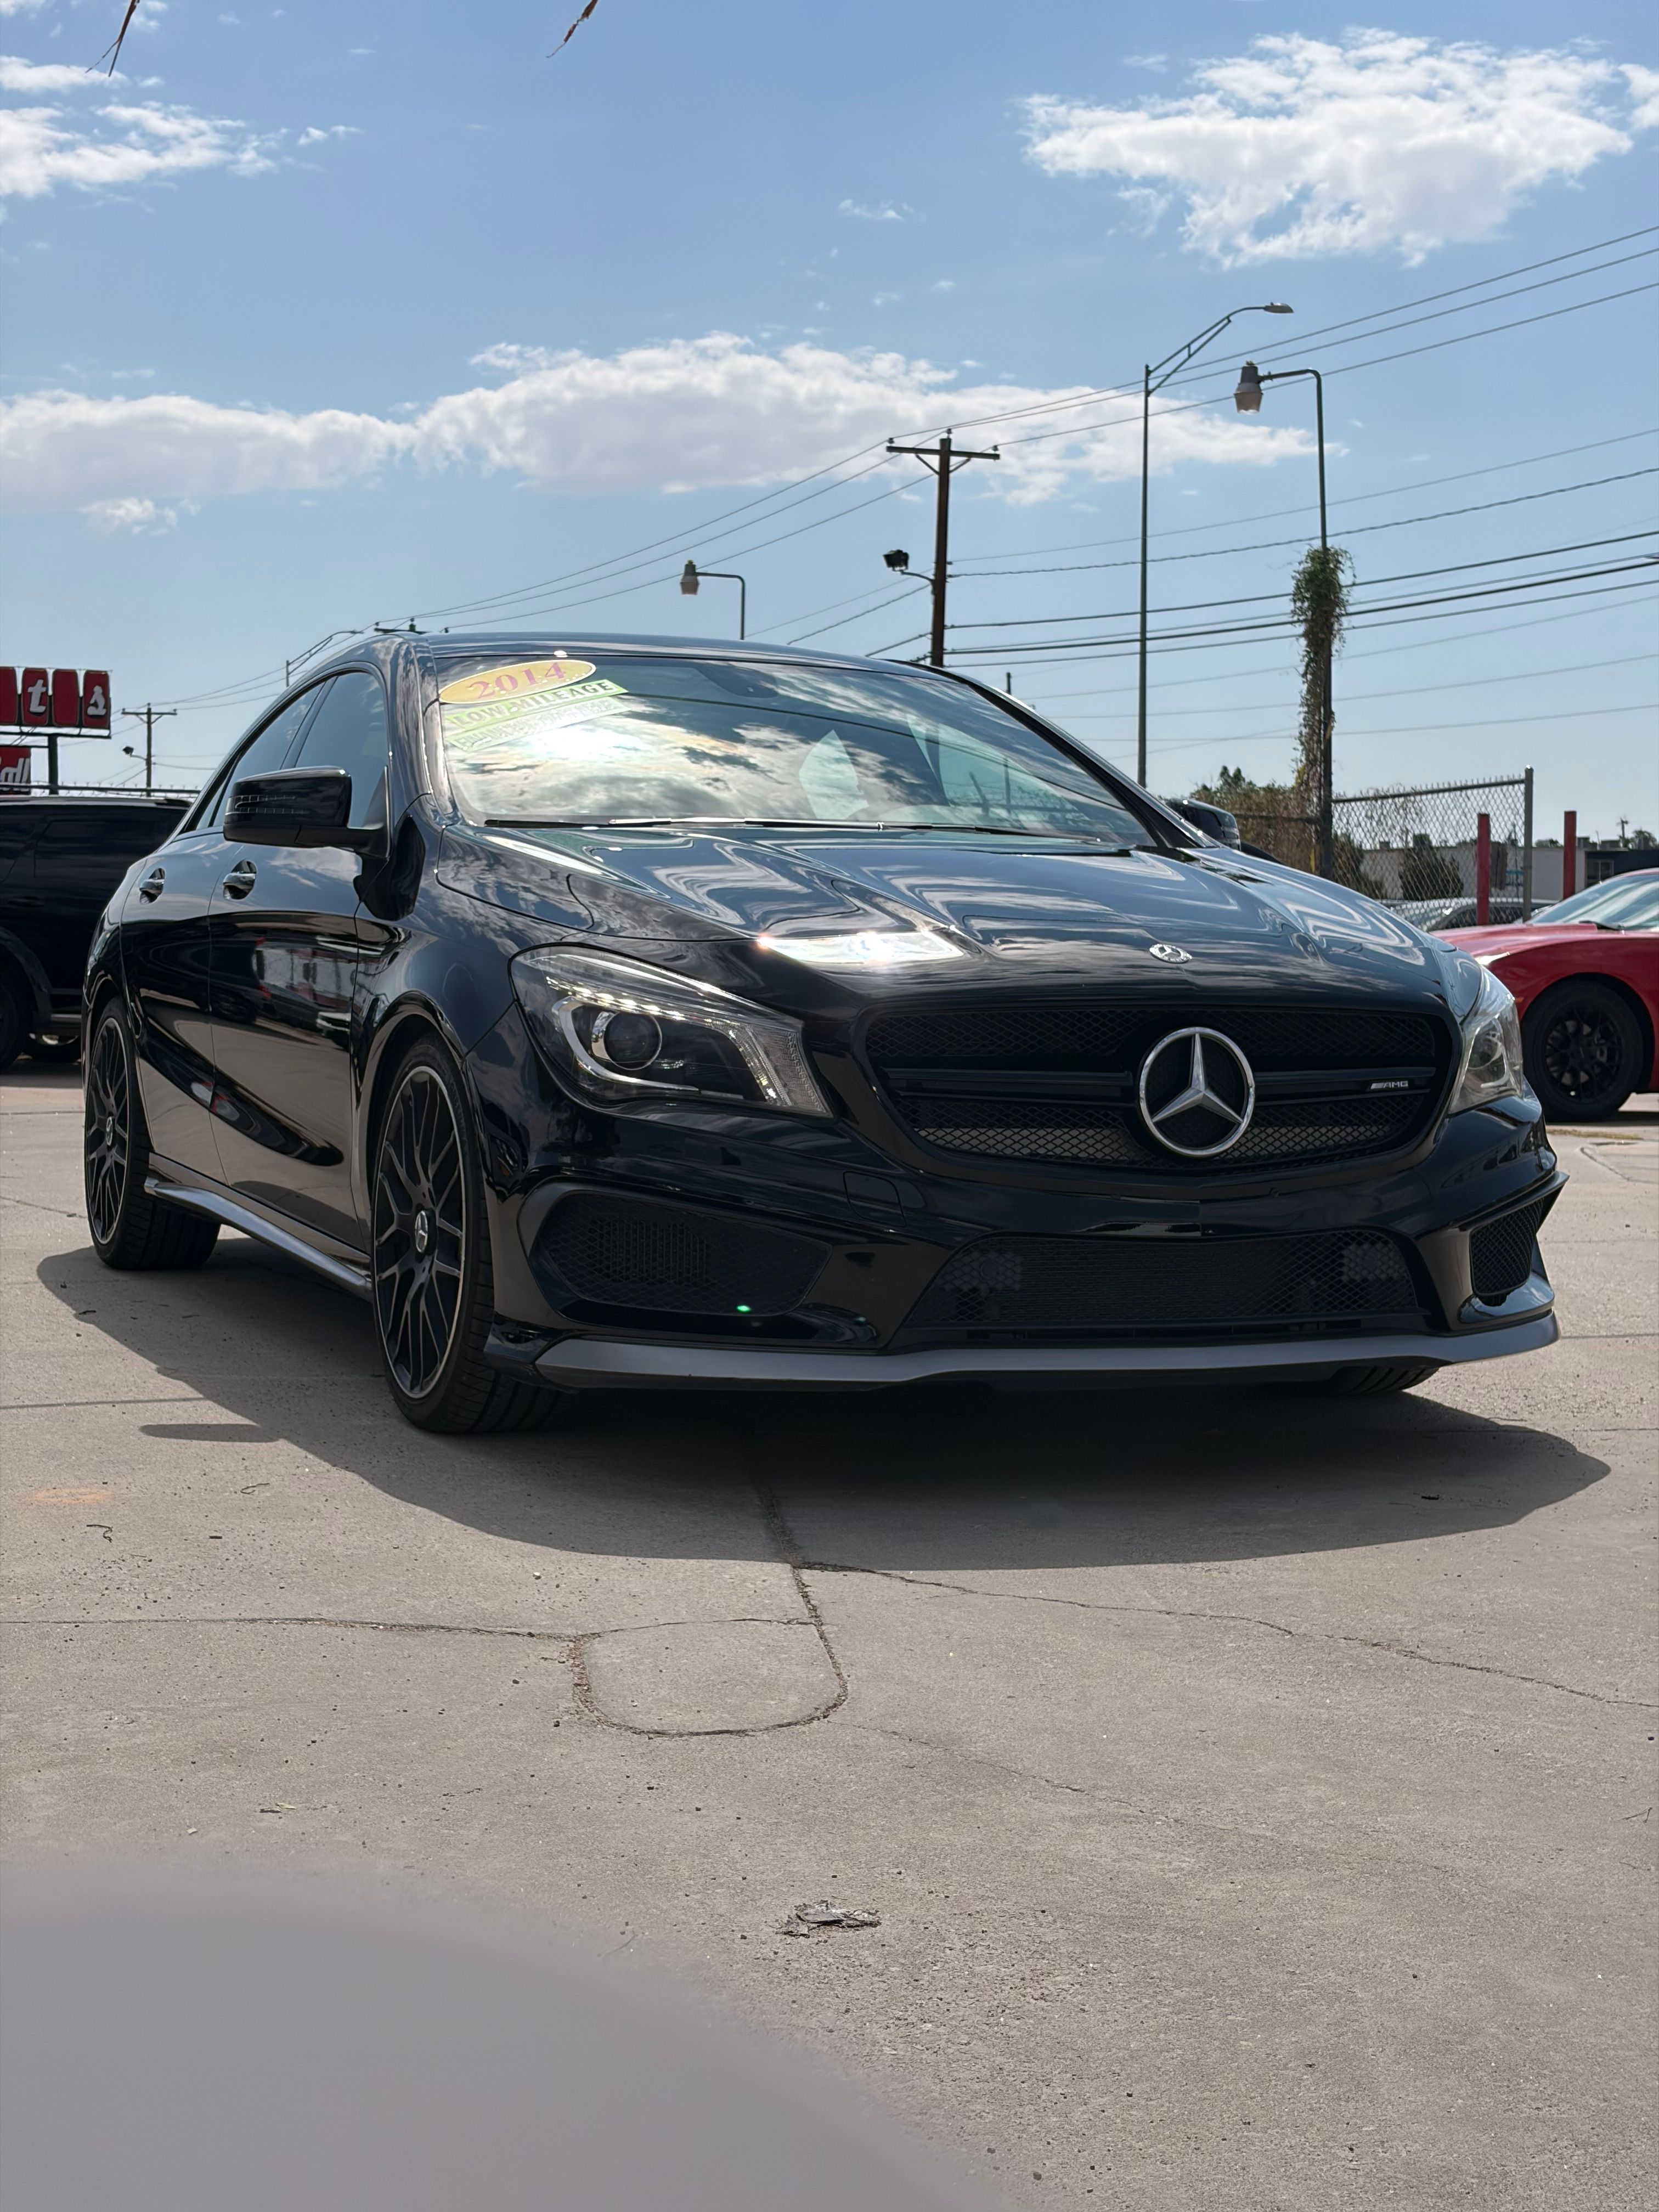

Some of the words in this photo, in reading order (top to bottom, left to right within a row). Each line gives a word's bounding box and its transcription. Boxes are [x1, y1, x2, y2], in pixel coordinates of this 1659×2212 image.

[467, 662, 566, 699] 2014
[453, 704, 509, 725] LOW
[510, 681, 614, 710] MILEAGE
[1383, 1081, 1409, 1089] AMG
